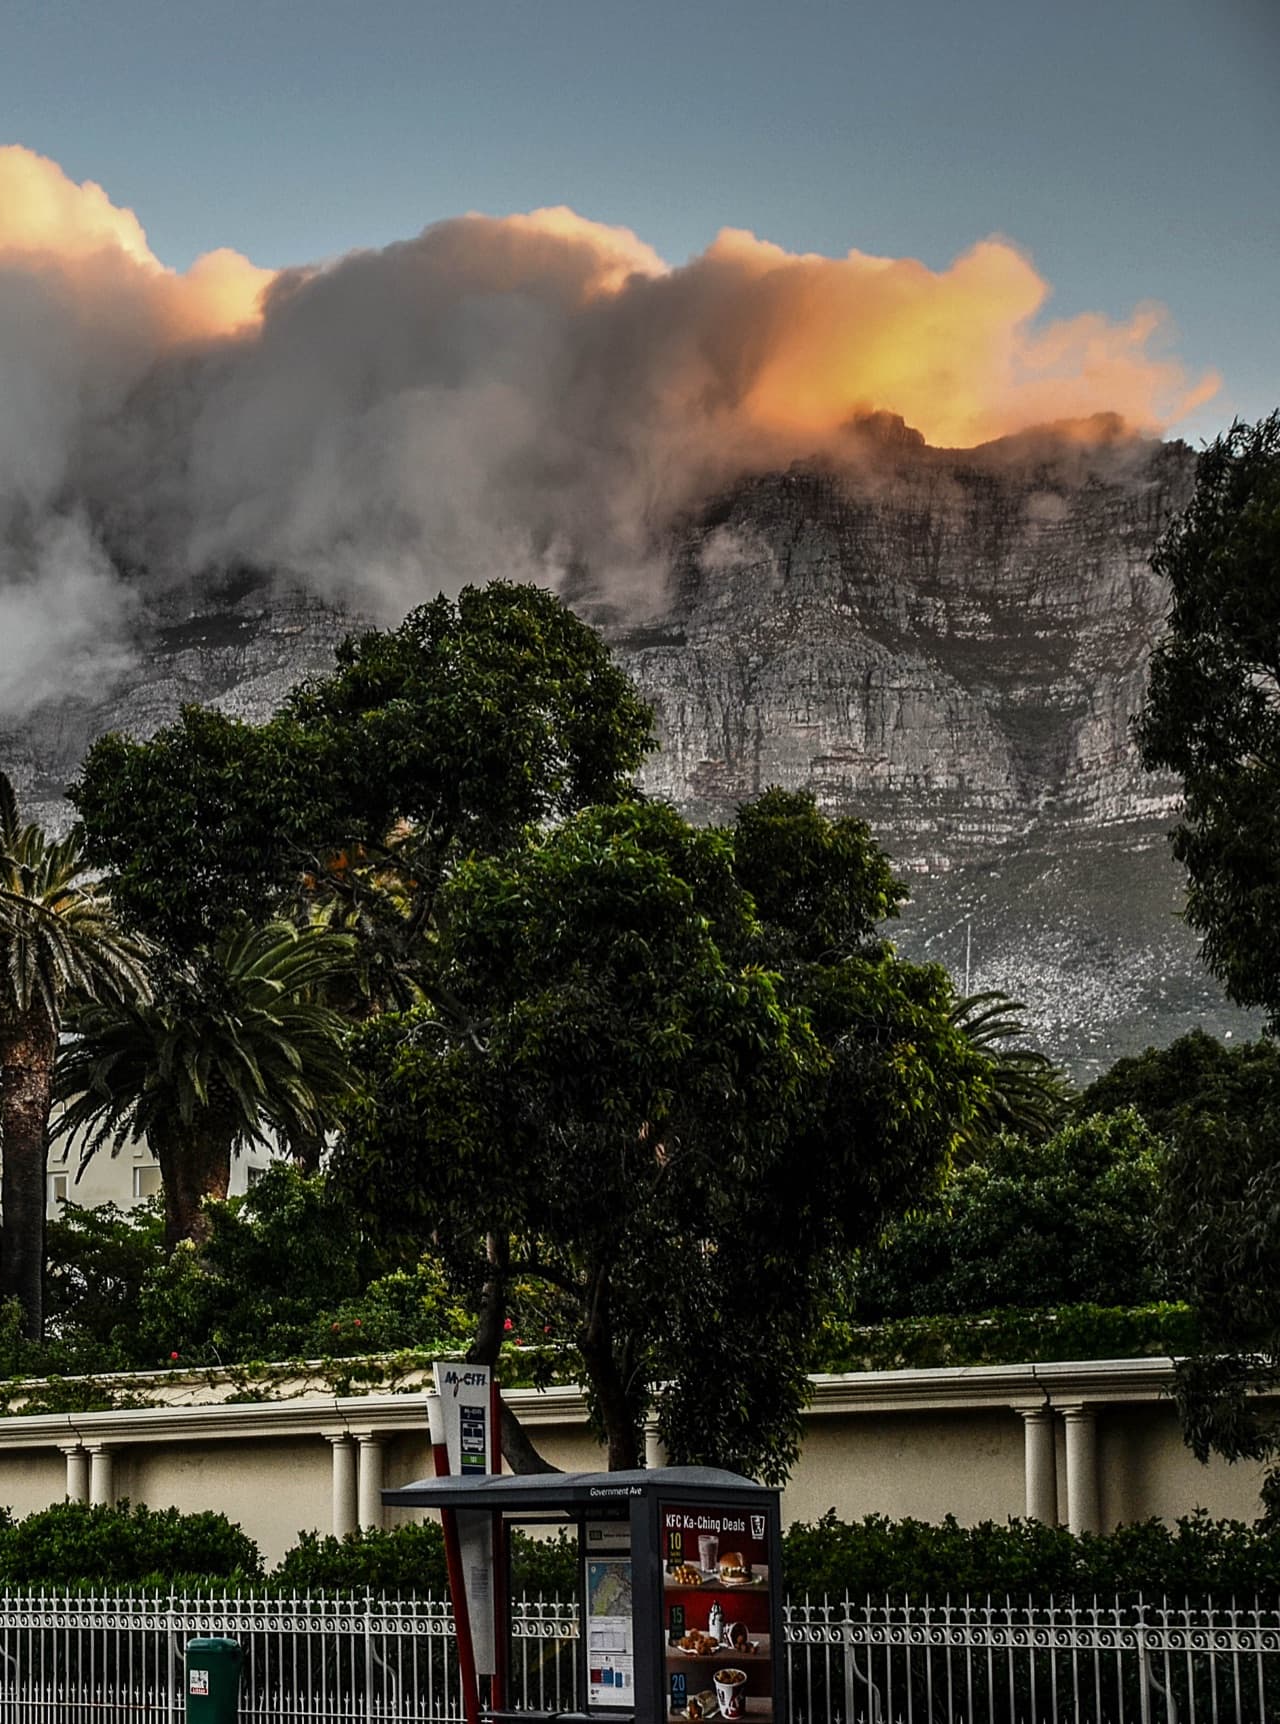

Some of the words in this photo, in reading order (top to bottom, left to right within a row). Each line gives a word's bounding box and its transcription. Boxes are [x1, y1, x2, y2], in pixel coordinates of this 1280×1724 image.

[590, 1487, 629, 1496] Government
[630, 1486, 642, 1495] Ave
[666, 1513, 682, 1528] KFC
[683, 1515, 720, 1533] Ka-Ching
[722, 1517, 745, 1532] Deals
[670, 1532, 682, 1550] 10
[672, 1606, 683, 1624] 15
[672, 1674, 686, 1692] 20
